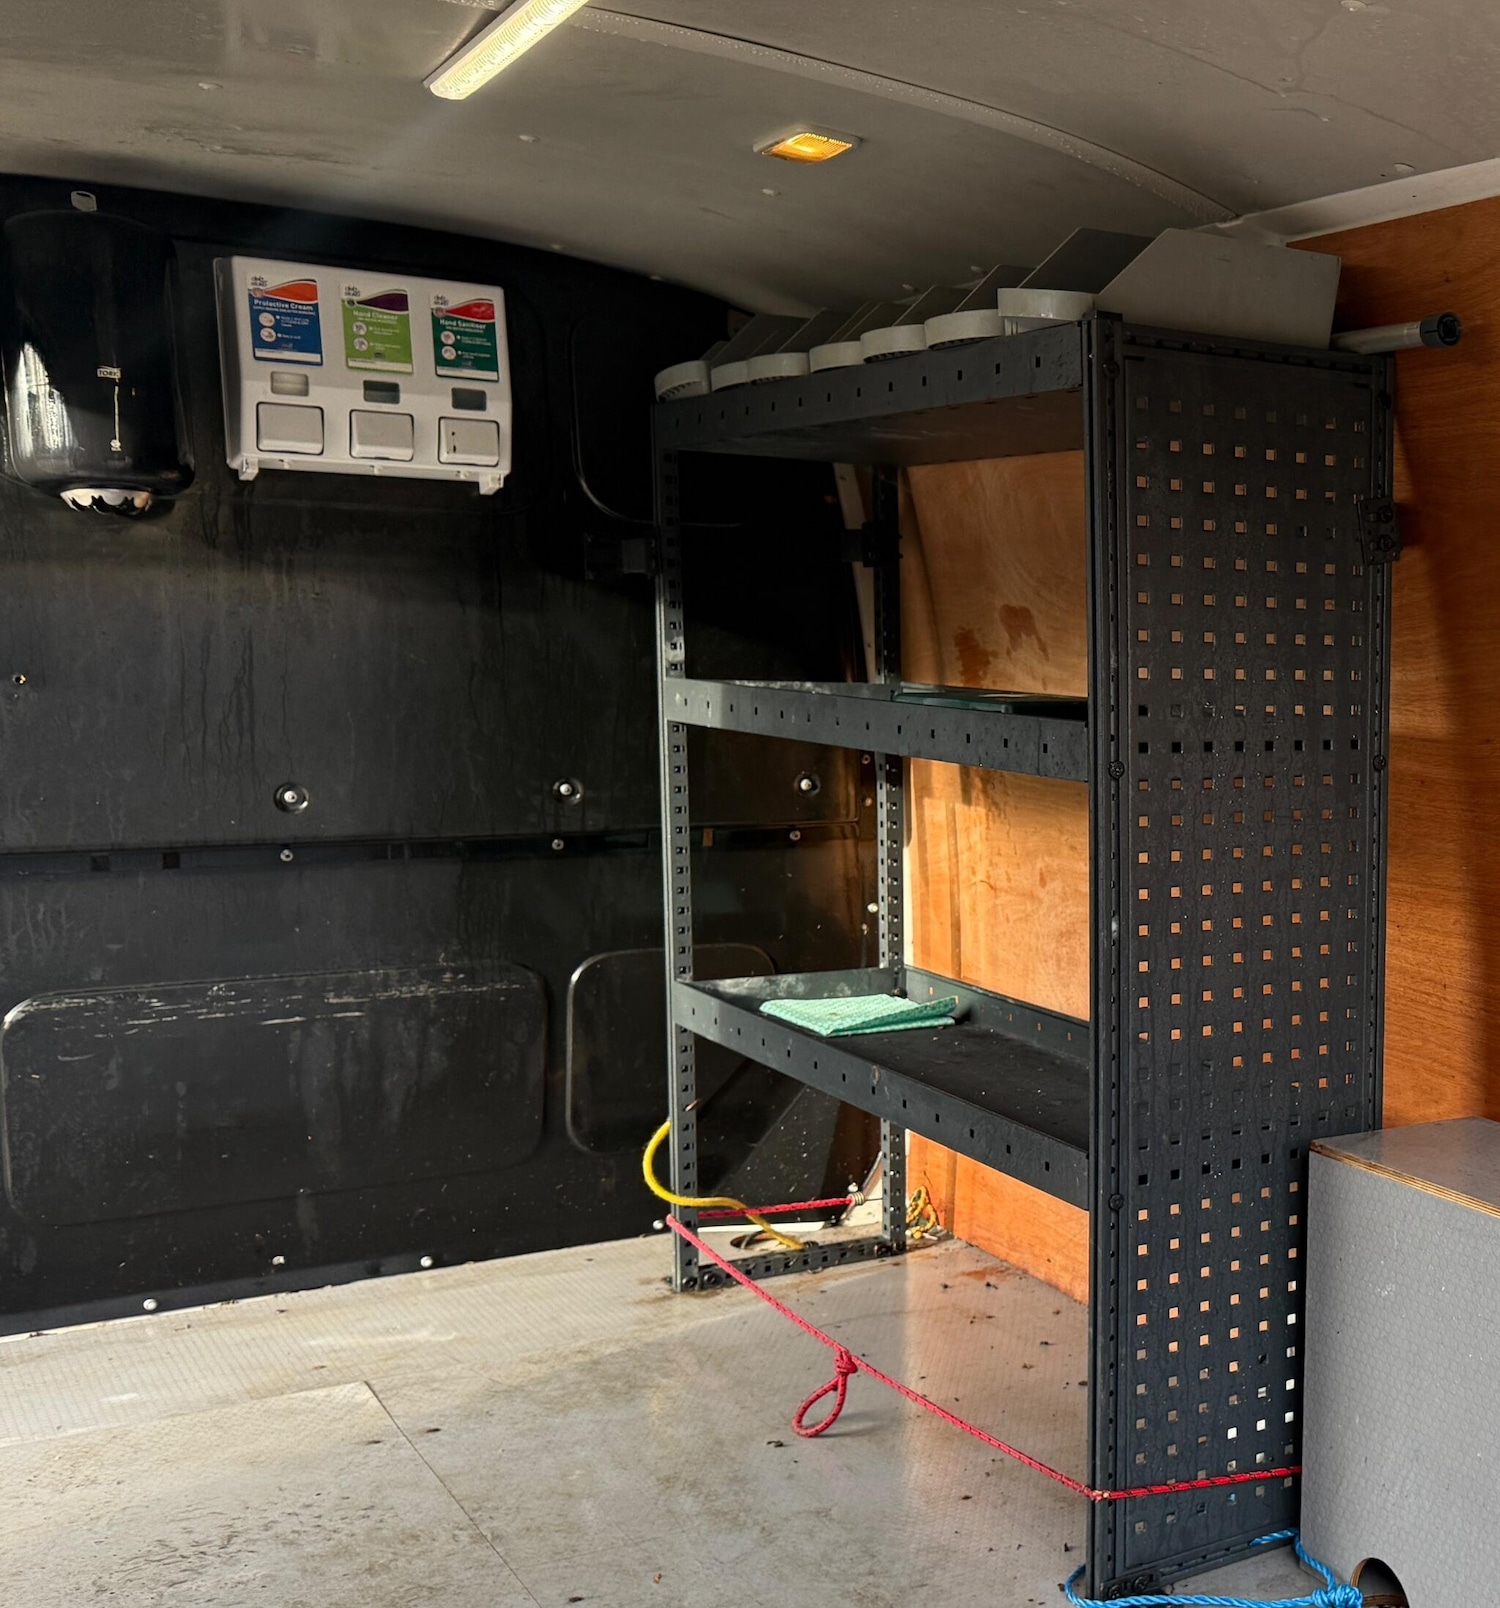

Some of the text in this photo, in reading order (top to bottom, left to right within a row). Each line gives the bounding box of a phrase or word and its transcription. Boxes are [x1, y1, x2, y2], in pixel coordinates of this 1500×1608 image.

[254, 299, 289, 308] Protective
[290, 303, 314, 311] Cream
[353, 310, 398, 320] Hand Cleaner
[440, 318, 457, 326] Hand
